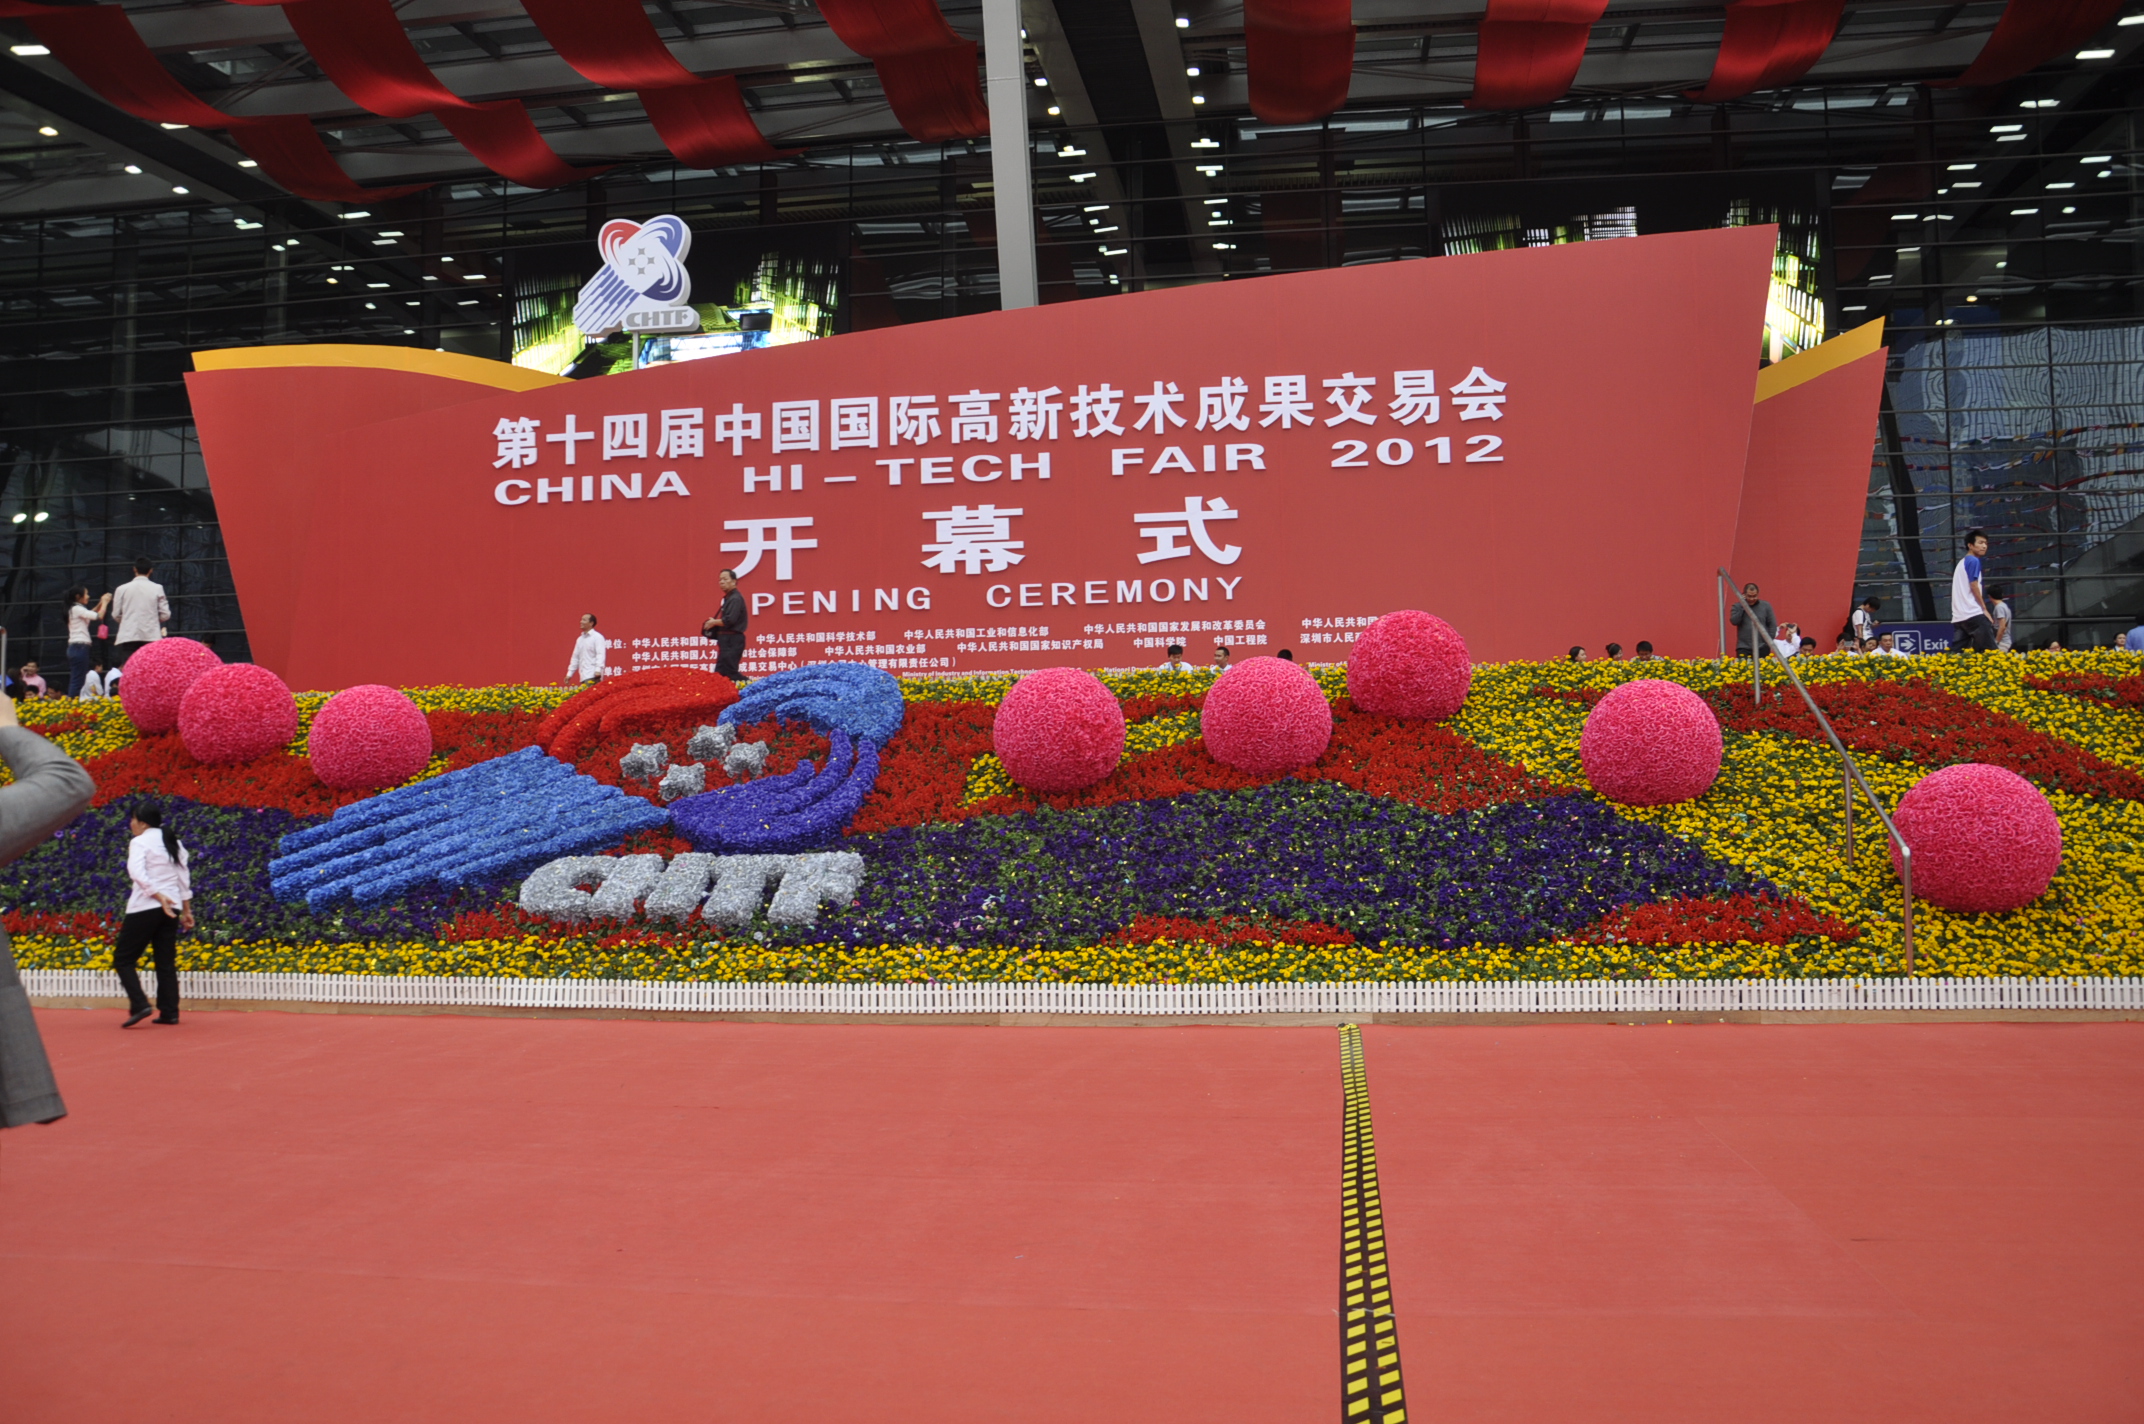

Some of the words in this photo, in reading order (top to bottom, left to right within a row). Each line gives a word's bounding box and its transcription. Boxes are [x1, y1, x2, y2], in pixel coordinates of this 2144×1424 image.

[626, 309, 688, 327] CHTF
[492, 366, 1508, 469] 第十四届中国国际高新技术成果交易会
[494, 470, 691, 506] CHINA
[1111, 443, 1267, 476] FAIR
[1331, 434, 1504, 468] 2012
[751, 587, 932, 616] PENING
[985, 576, 1243, 608] CEREMONY
[756, 630, 876, 644] 中华人民共和国科学技术部
[904, 626, 1049, 640] 中华人民共和国工业和信息化部
[1083, 619, 1266, 635] 中华人民共和国国家发展和改革委员会
[1301, 616, 1379, 629] 中华人民共和国
[825, 644, 926, 656] 中华人民共和国农业部
[957, 639, 1104, 652] 中华人民共和国国家知识产权局
[1133, 636, 1187, 648] 中国科学院
[1213, 634, 1268, 646] 中国工程院
[1300, 632, 1361, 644] 深圳市人民
[1924, 638, 1949, 650] Exit
